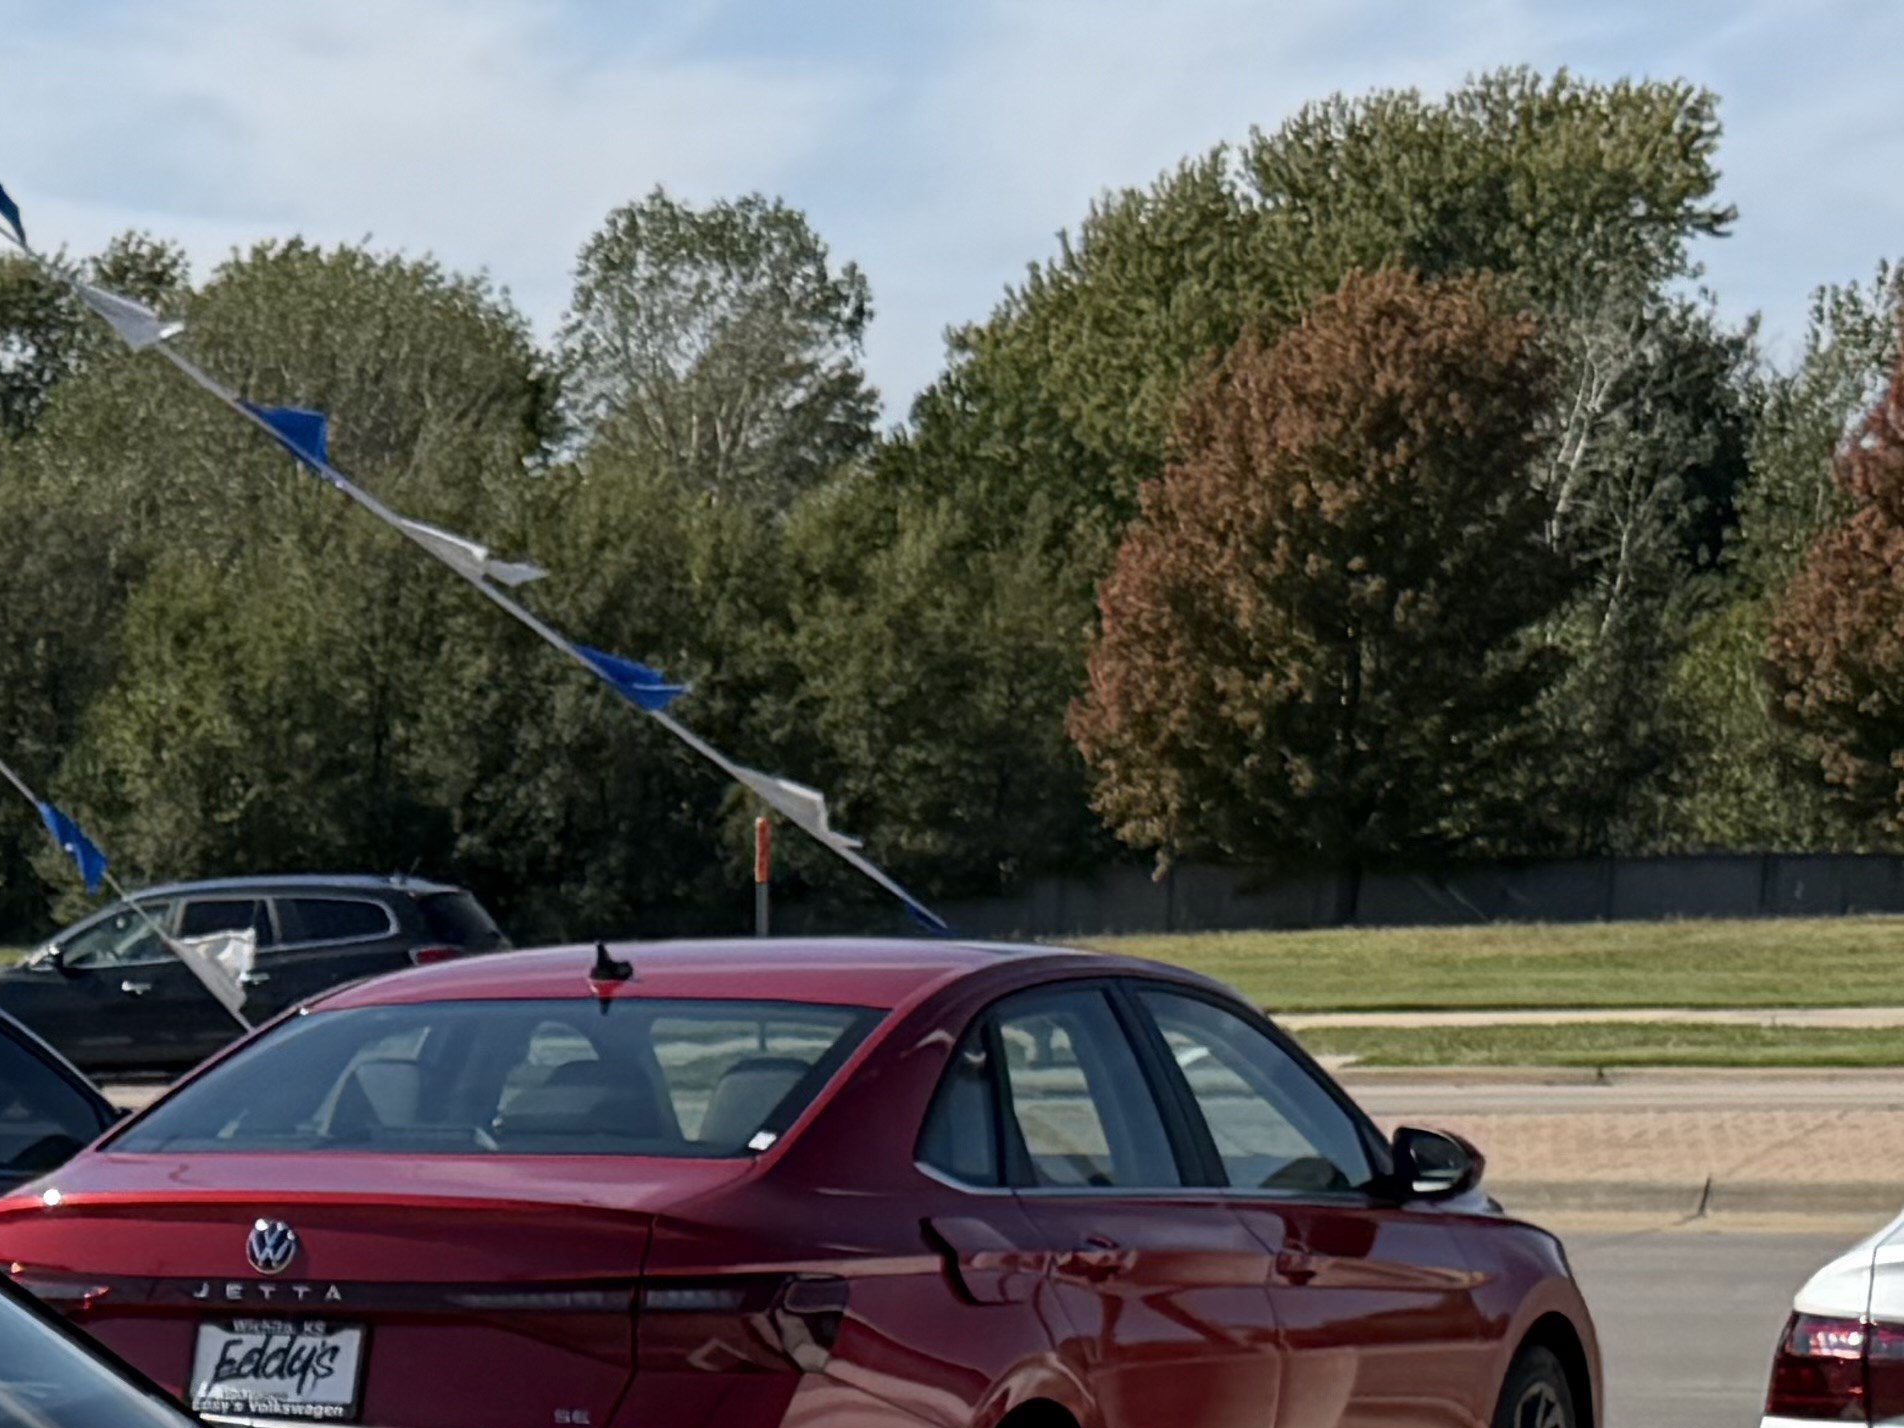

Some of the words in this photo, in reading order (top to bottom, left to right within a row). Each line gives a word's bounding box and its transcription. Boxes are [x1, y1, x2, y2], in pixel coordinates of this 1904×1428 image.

[193, 1282, 342, 1299] JETTA
[205, 1333, 341, 1396] Eddy's
[248, 1397, 344, 1418] Volkswagen
